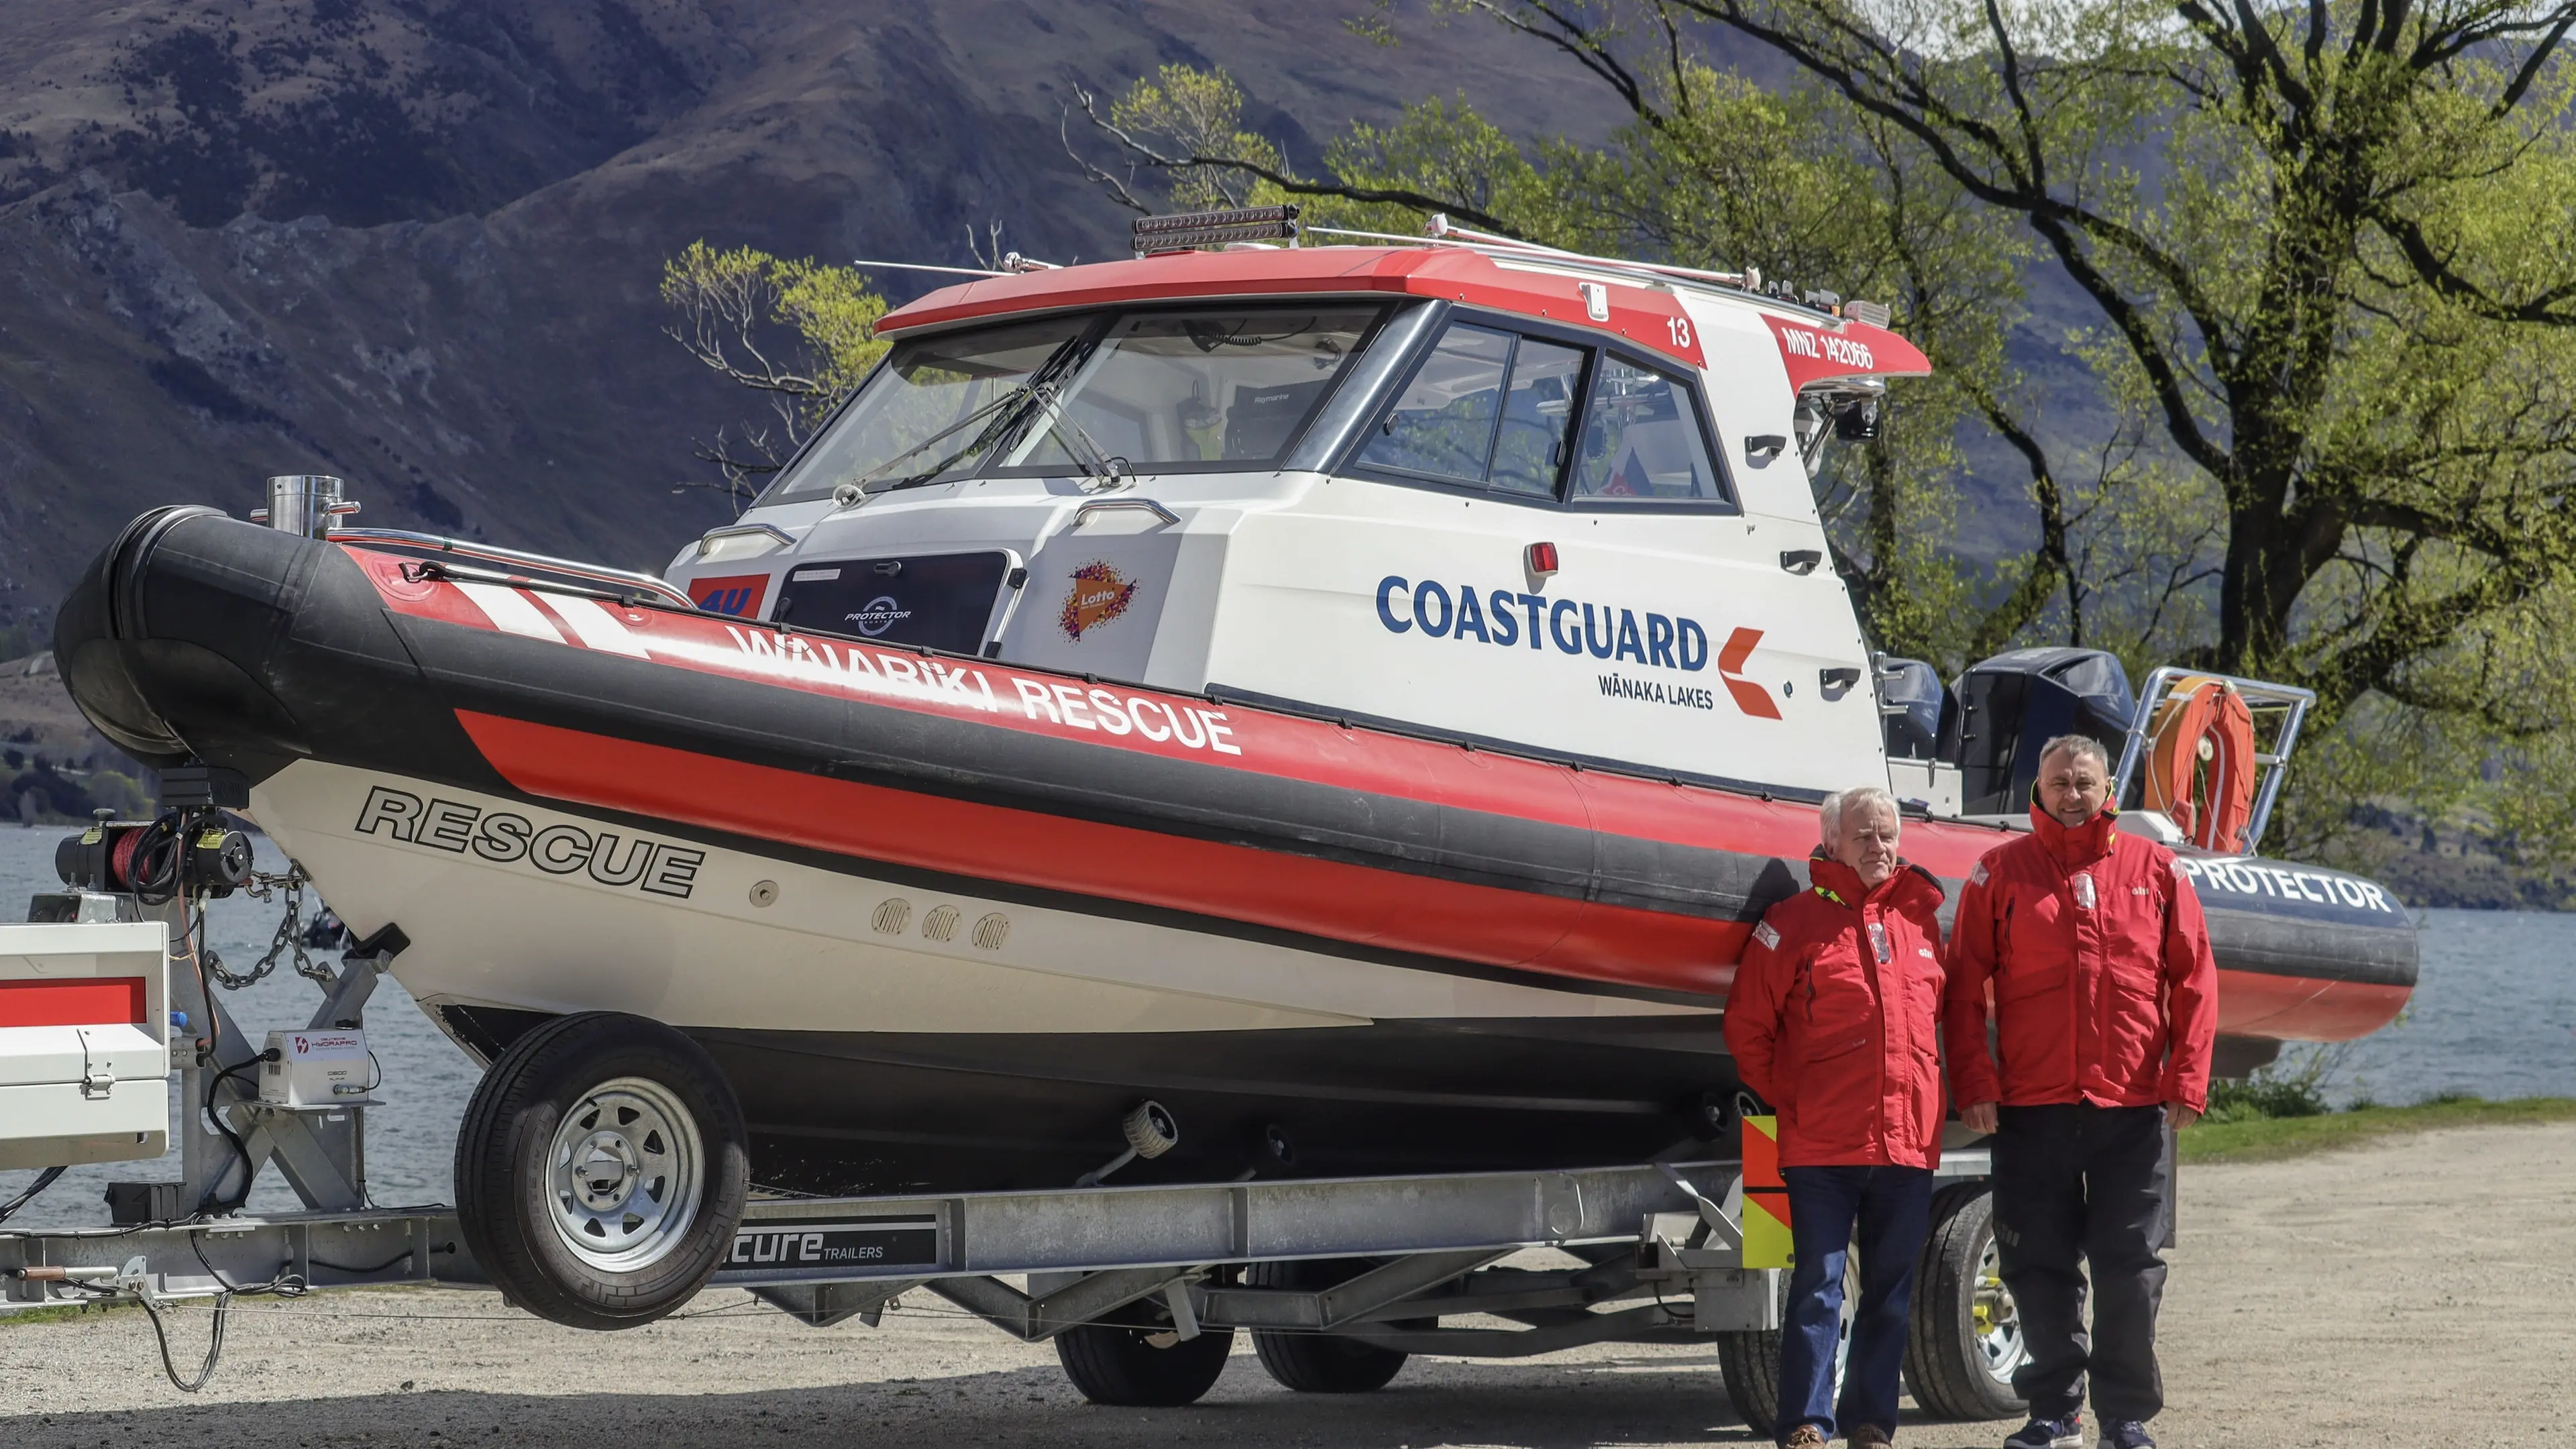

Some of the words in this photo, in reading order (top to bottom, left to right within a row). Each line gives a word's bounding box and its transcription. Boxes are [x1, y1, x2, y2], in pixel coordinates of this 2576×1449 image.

[1666, 317, 1690, 348] 13
[1781, 327, 1821, 359] MNZ
[1819, 335, 1874, 370] 142066
[1254, 393, 1289, 404] Raymarine
[844, 611, 912, 621] PROTECTOR
[1081, 590, 1115, 605] Lotto
[1376, 575, 1709, 672] COASTGUARD
[724, 625, 998, 713] WAIARIKI
[1010, 677, 1242, 756] RESCUE
[1598, 673, 1665, 704] WĀNAKA
[1668, 684, 1714, 710] LAKES
[354, 790, 706, 900] RESCUE
[2180, 856, 2392, 913] PROTECTOR
[823, 1246, 883, 1260] TRAILERS
